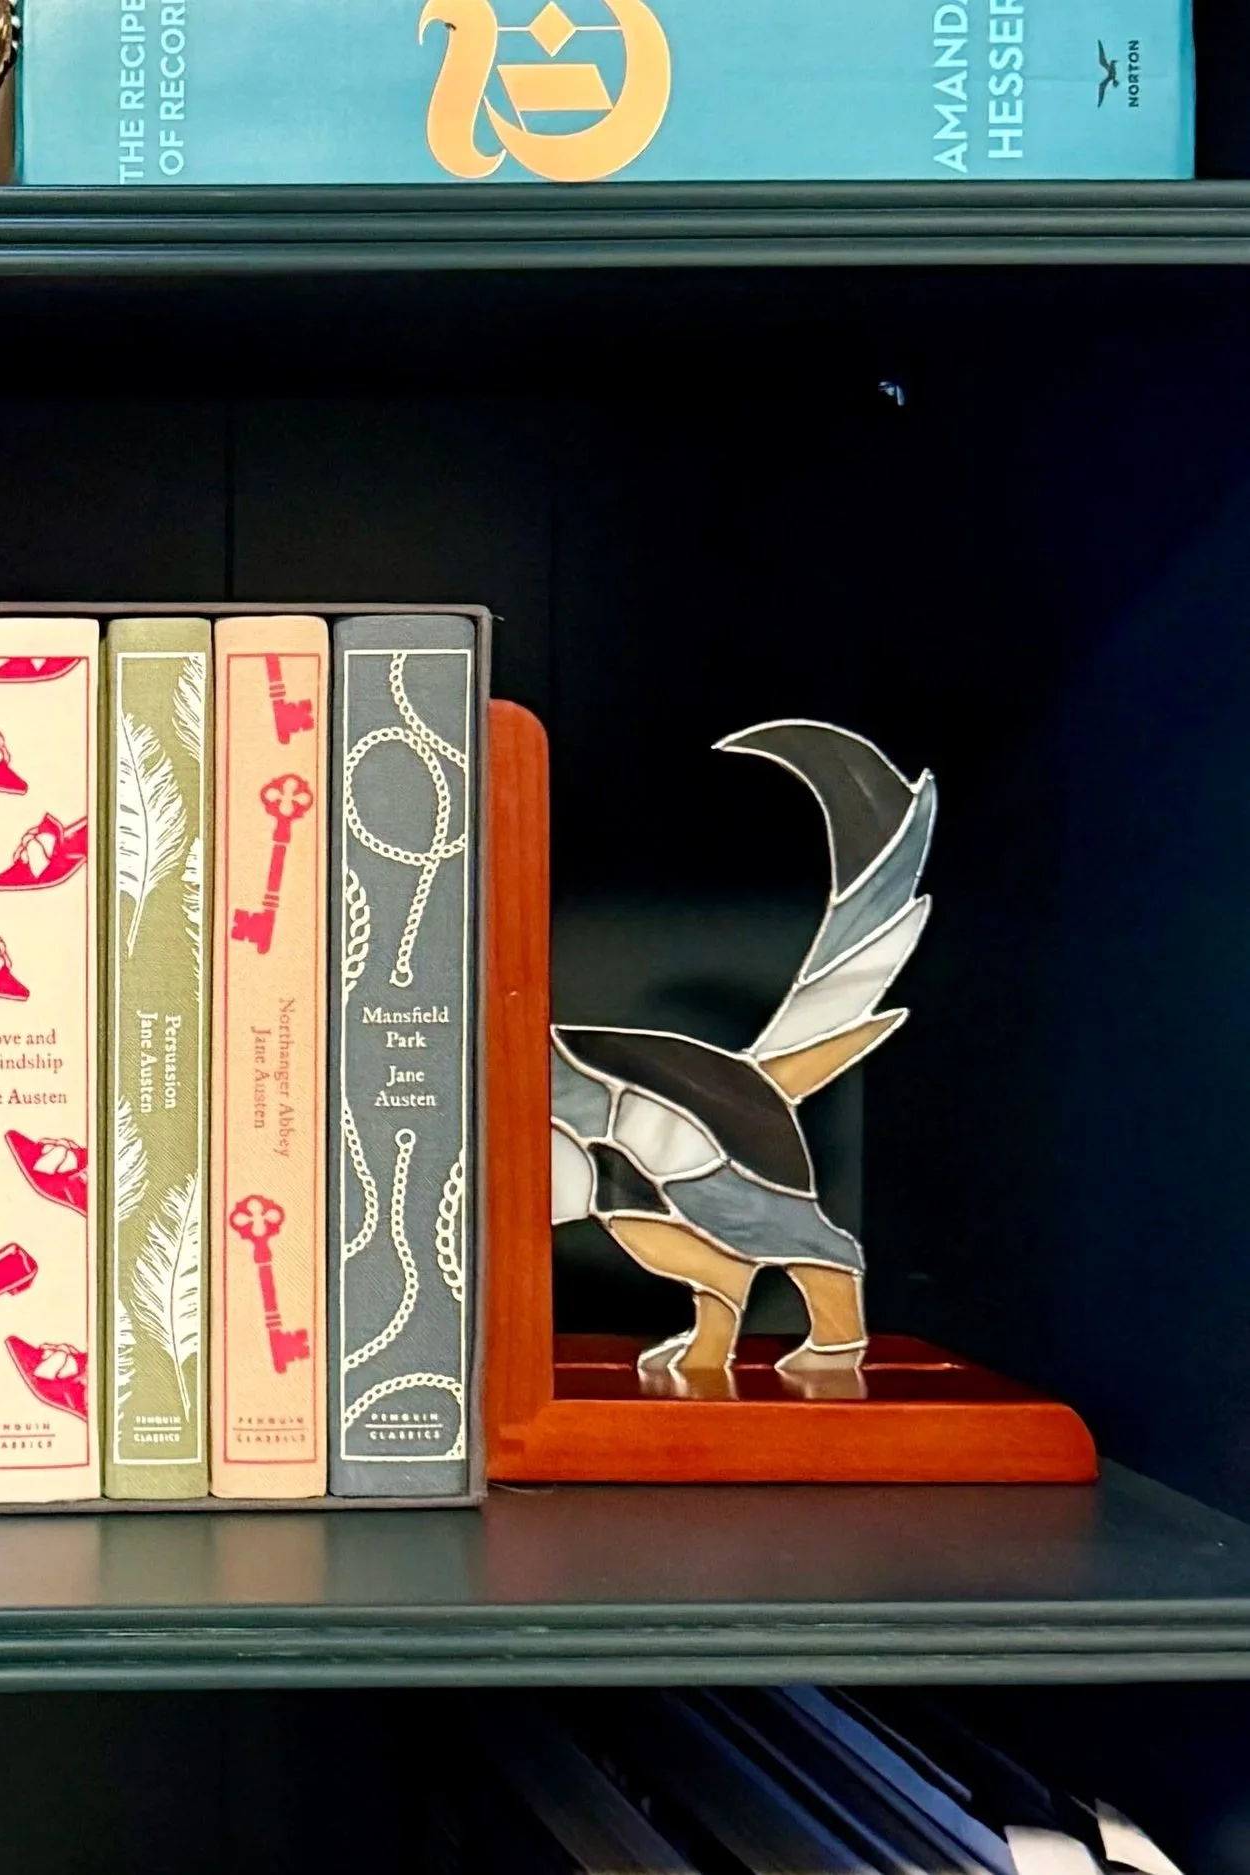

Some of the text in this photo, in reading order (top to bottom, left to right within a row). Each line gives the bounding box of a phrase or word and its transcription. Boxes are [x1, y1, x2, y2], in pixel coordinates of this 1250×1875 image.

[159, 0, 186, 176] OF RECOR
[933, 0, 968, 173] AMAND
[1128, 39, 1140, 108] NORTON
[119, 119, 145, 184] THE
[362, 1006, 450, 1024] Mansfield
[26, 1029, 57, 1046] and
[386, 1031, 427, 1048] Park
[137, 1010, 158, 1113] Jane Austen
[165, 1014, 181, 1109] Persuasion
[251, 1026, 271, 1129] Jane Austen
[273, 997, 296, 1157] Northanger Abbey
[386, 1065, 425, 1085] Jane
[7, 1088, 67, 1105] Austen
[373, 1090, 436, 1107] Austen
[369, 1430, 440, 1440] CLASSICS
[370, 1413, 439, 1422] PENGUIN
